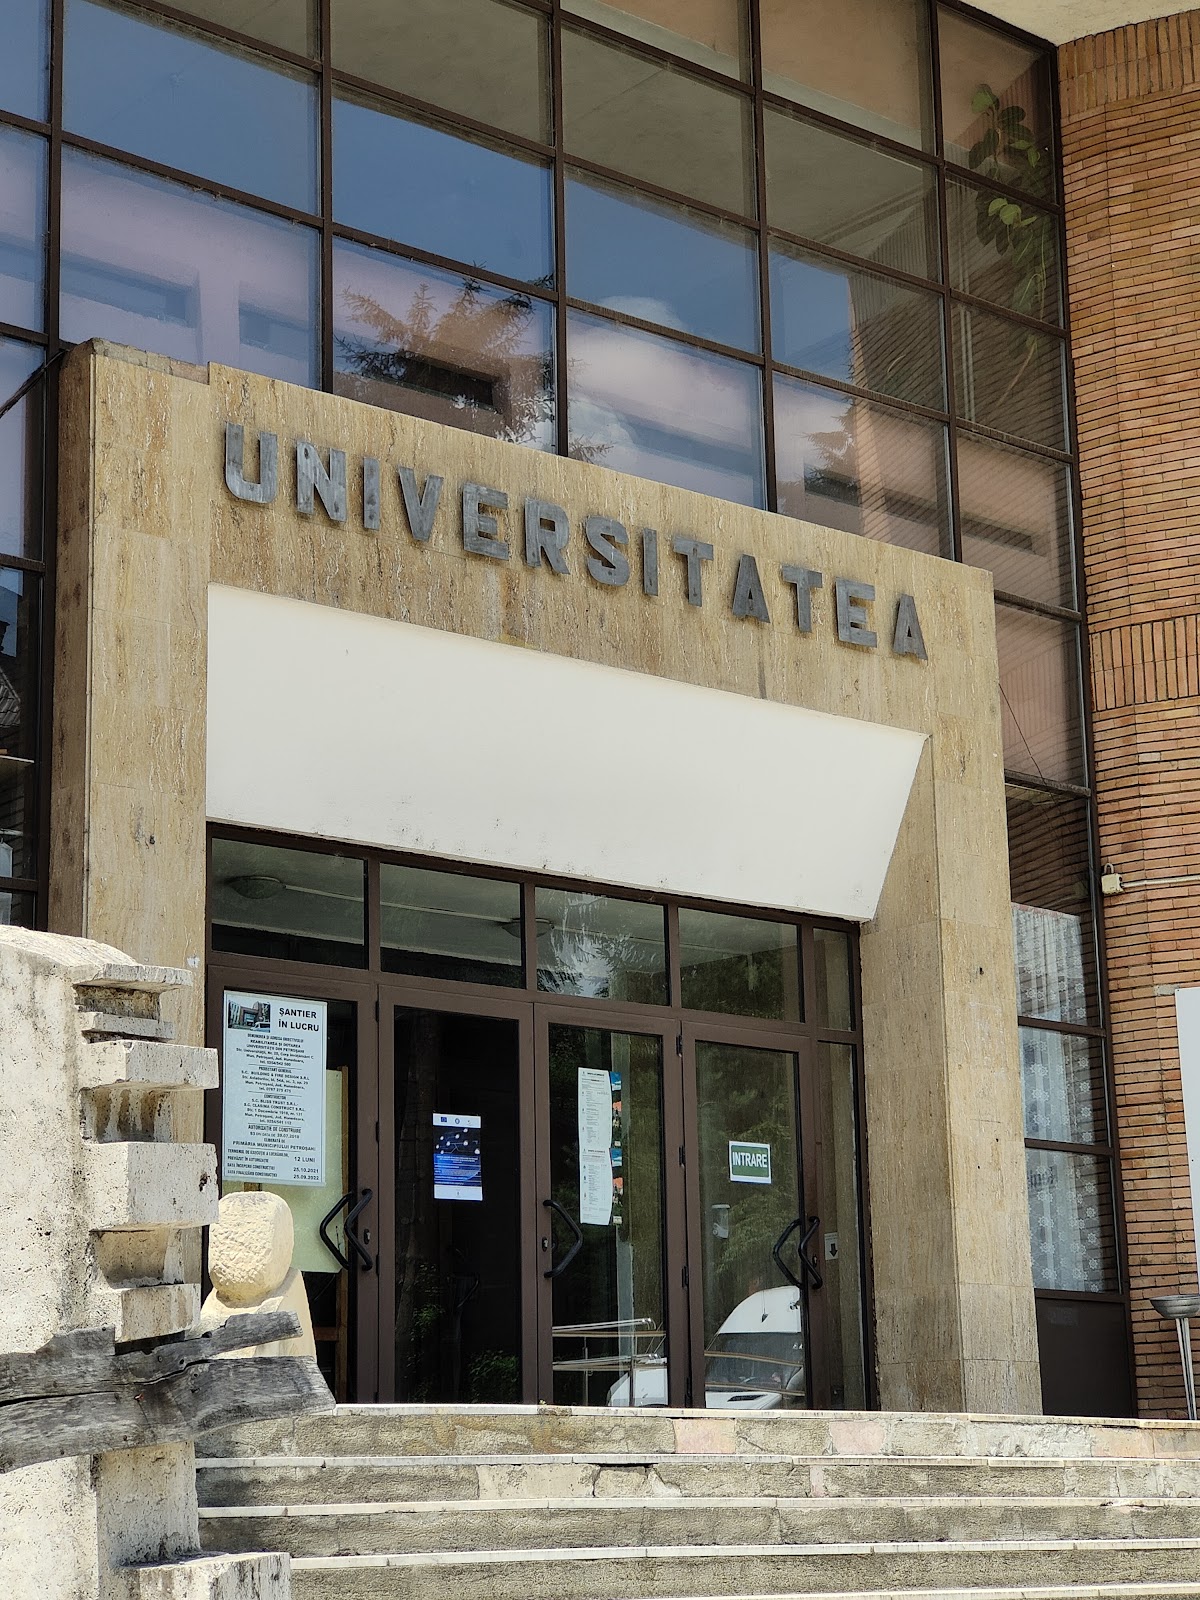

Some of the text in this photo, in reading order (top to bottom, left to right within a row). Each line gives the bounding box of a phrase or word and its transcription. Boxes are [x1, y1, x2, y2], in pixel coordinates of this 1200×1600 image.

[224, 422, 929, 660] UNIVERSITATEA
[278, 1018, 320, 1032] ÎN LUCRU
[732, 1151, 768, 1168] INTRARE
